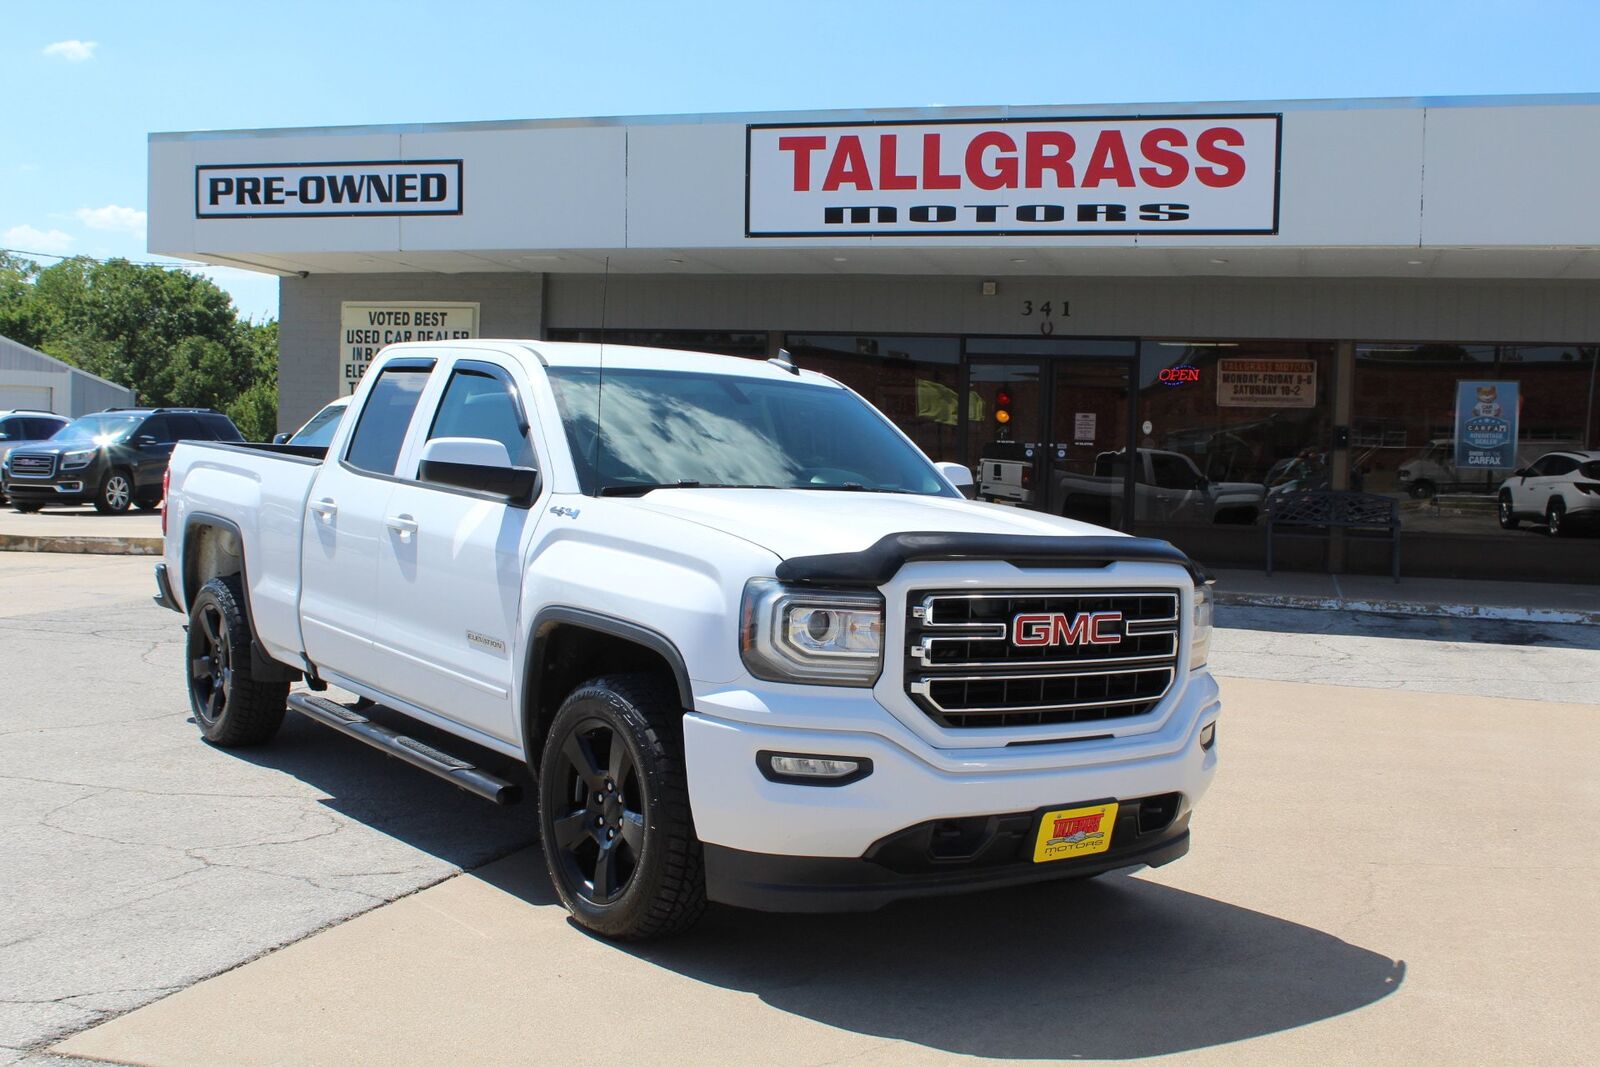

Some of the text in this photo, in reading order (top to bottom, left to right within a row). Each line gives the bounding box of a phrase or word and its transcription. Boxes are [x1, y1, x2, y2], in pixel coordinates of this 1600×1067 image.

[779, 127, 1246, 191] TALLGRASS
[209, 173, 447, 205] PRE-OWNED
[824, 203, 1190, 224] MOTORS
[369, 311, 448, 326] VOTED BEST
[346, 330, 470, 344] USED CAR DEALER
[352, 347, 363, 361] IN
[345, 364, 369, 378] ELE
[1158, 368, 1201, 382] OPEN
[1222, 373, 1294, 384] MONDAY-FRIDAY
[1233, 384, 1301, 396] SATURDAY 10-2
[1468, 456, 1501, 465] CARFAX
[1013, 611, 1122, 647] GMC
[467, 632, 503, 649] ELEVATION
[1045, 840, 1104, 854] MOTORS
